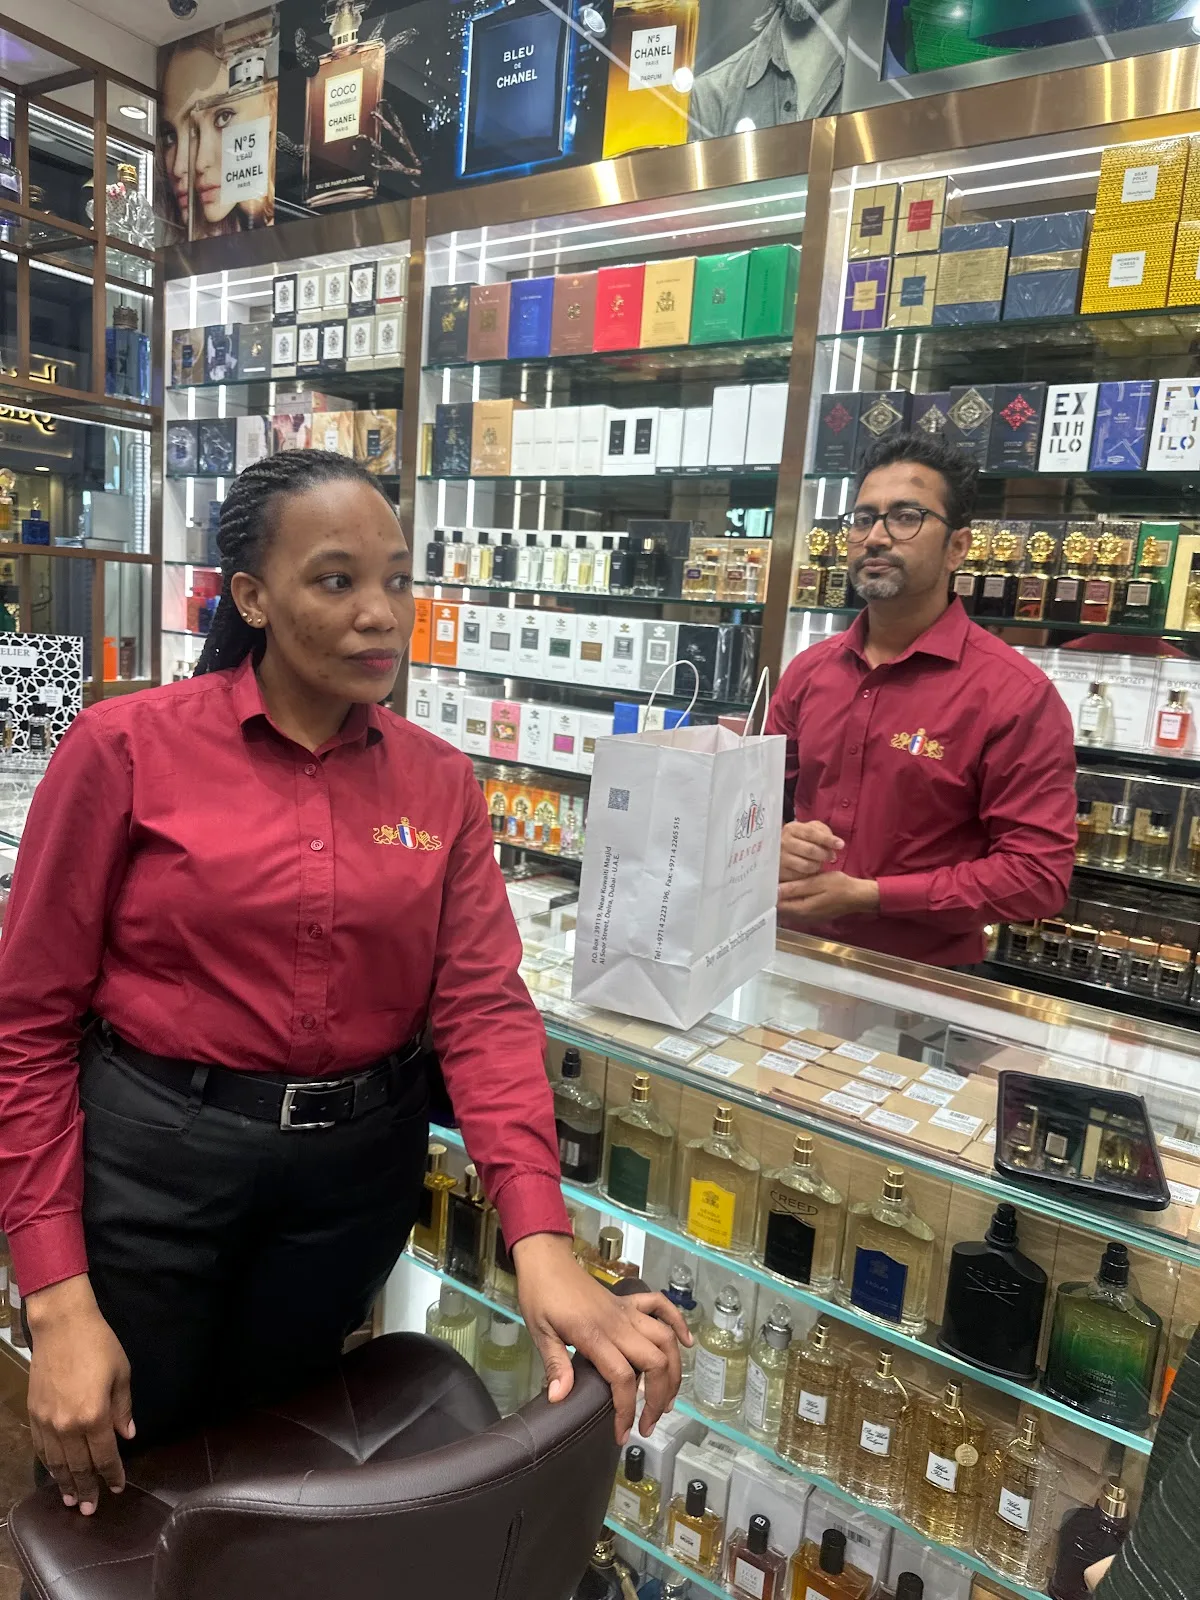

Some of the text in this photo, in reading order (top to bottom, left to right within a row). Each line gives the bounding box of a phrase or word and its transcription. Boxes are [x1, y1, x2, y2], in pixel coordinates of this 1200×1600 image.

[503, 44, 534, 62] BLEU
[634, 45, 672, 59] CHANEL
[496, 68, 538, 88] CHANEL
[640, 73, 662, 81] PARFUM
[330, 83, 357, 99] COCO
[328, 113, 357, 127] CHANEL
[335, 125, 348, 133] PARIS
[226, 165, 263, 182] CHANEL
[1054, 392, 1088, 415] EX
[604, 846, 612, 868] Masjid
[600, 869, 609, 893] Kuwaiti
[608, 877, 616, 898] Dubai
[660, 905, 668, 922] 2223
[668, 855, 676, 871] +971
[770, 1190, 818, 1215] CREED
